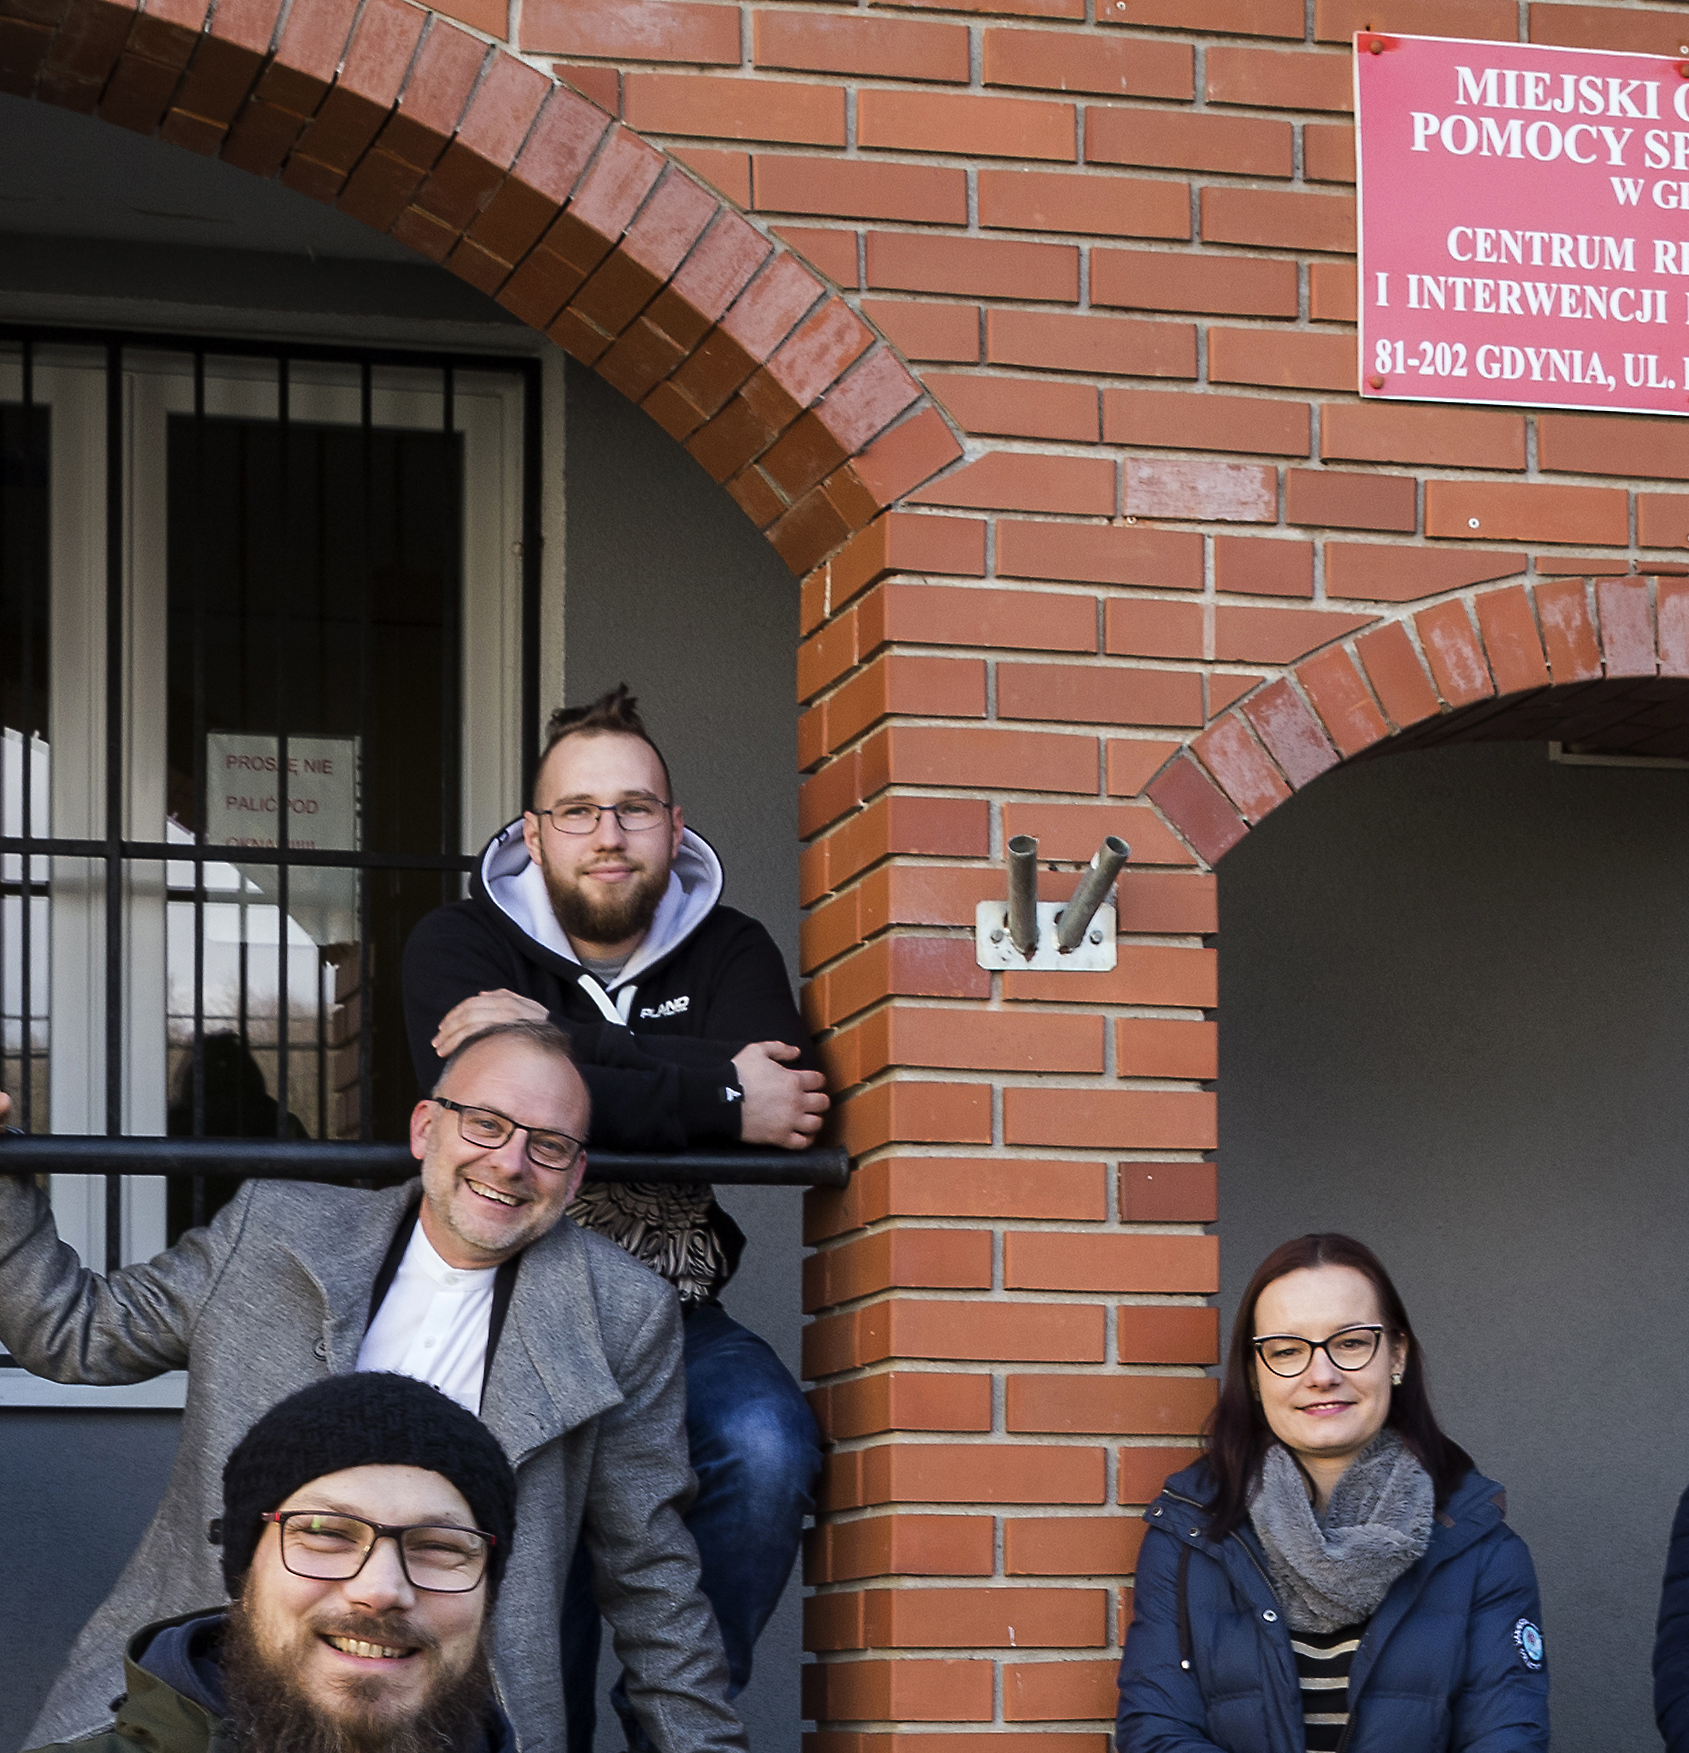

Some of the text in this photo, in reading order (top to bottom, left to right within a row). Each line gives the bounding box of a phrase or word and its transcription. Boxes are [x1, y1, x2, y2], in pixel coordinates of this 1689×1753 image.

[1454, 65, 1661, 120] MIEJSKI
[1409, 111, 1634, 167] POMOCY
[1609, 176, 1645, 207] W
[1446, 225, 1637, 273] CENTRUM
[1375, 271, 1390, 307] I
[1406, 273, 1669, 325] INTERWENCJI
[1374, 338, 1468, 378] 81-202
[1475, 344, 1617, 392] GDYNIA,
[1622, 352, 1677, 390] UL.
[225, 754, 333, 775] PROSĘ NIE
